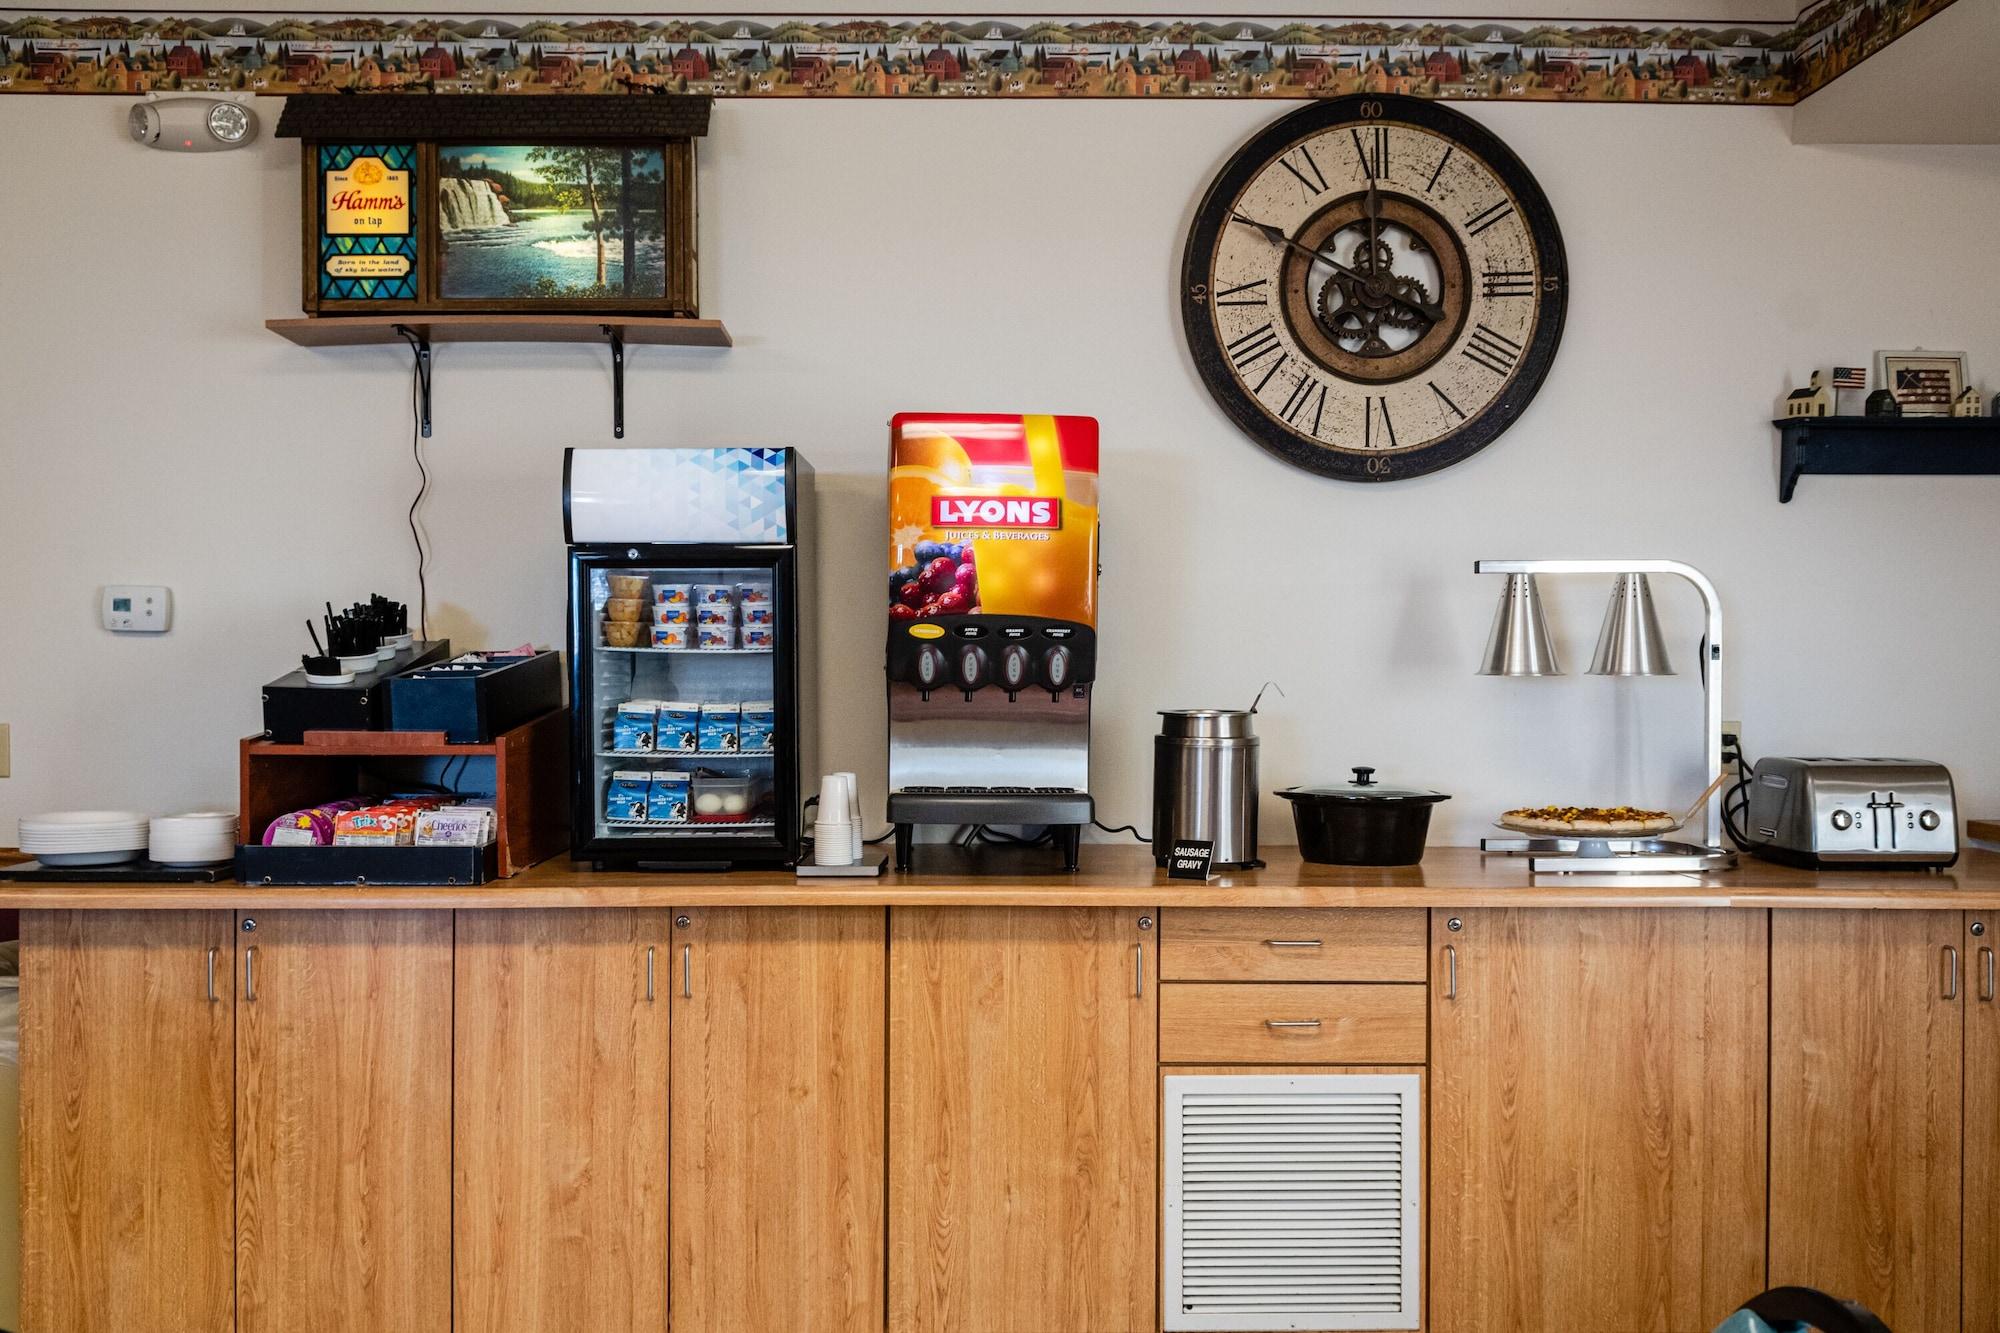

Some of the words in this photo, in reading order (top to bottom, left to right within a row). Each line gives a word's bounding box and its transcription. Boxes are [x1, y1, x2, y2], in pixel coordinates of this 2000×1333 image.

[1360, 101, 1383, 118] 60
[330, 190, 406, 211] Hamm's
[368, 217, 383, 228] tap
[1544, 277, 1559, 292] 15
[1195, 284, 1208, 304] 45
[1366, 457, 1391, 475] 30
[940, 500, 1051, 523] LYONS
[946, 530, 980, 541] JUICES
[983, 532, 991, 540] &
[993, 531, 1051, 541] BEVERAGES
[351, 814, 378, 829] Trix
[432, 820, 467, 831] Cheerios
[1174, 847, 1210, 858] SAUSAGE
[1177, 859, 1203, 869] GRAVY
